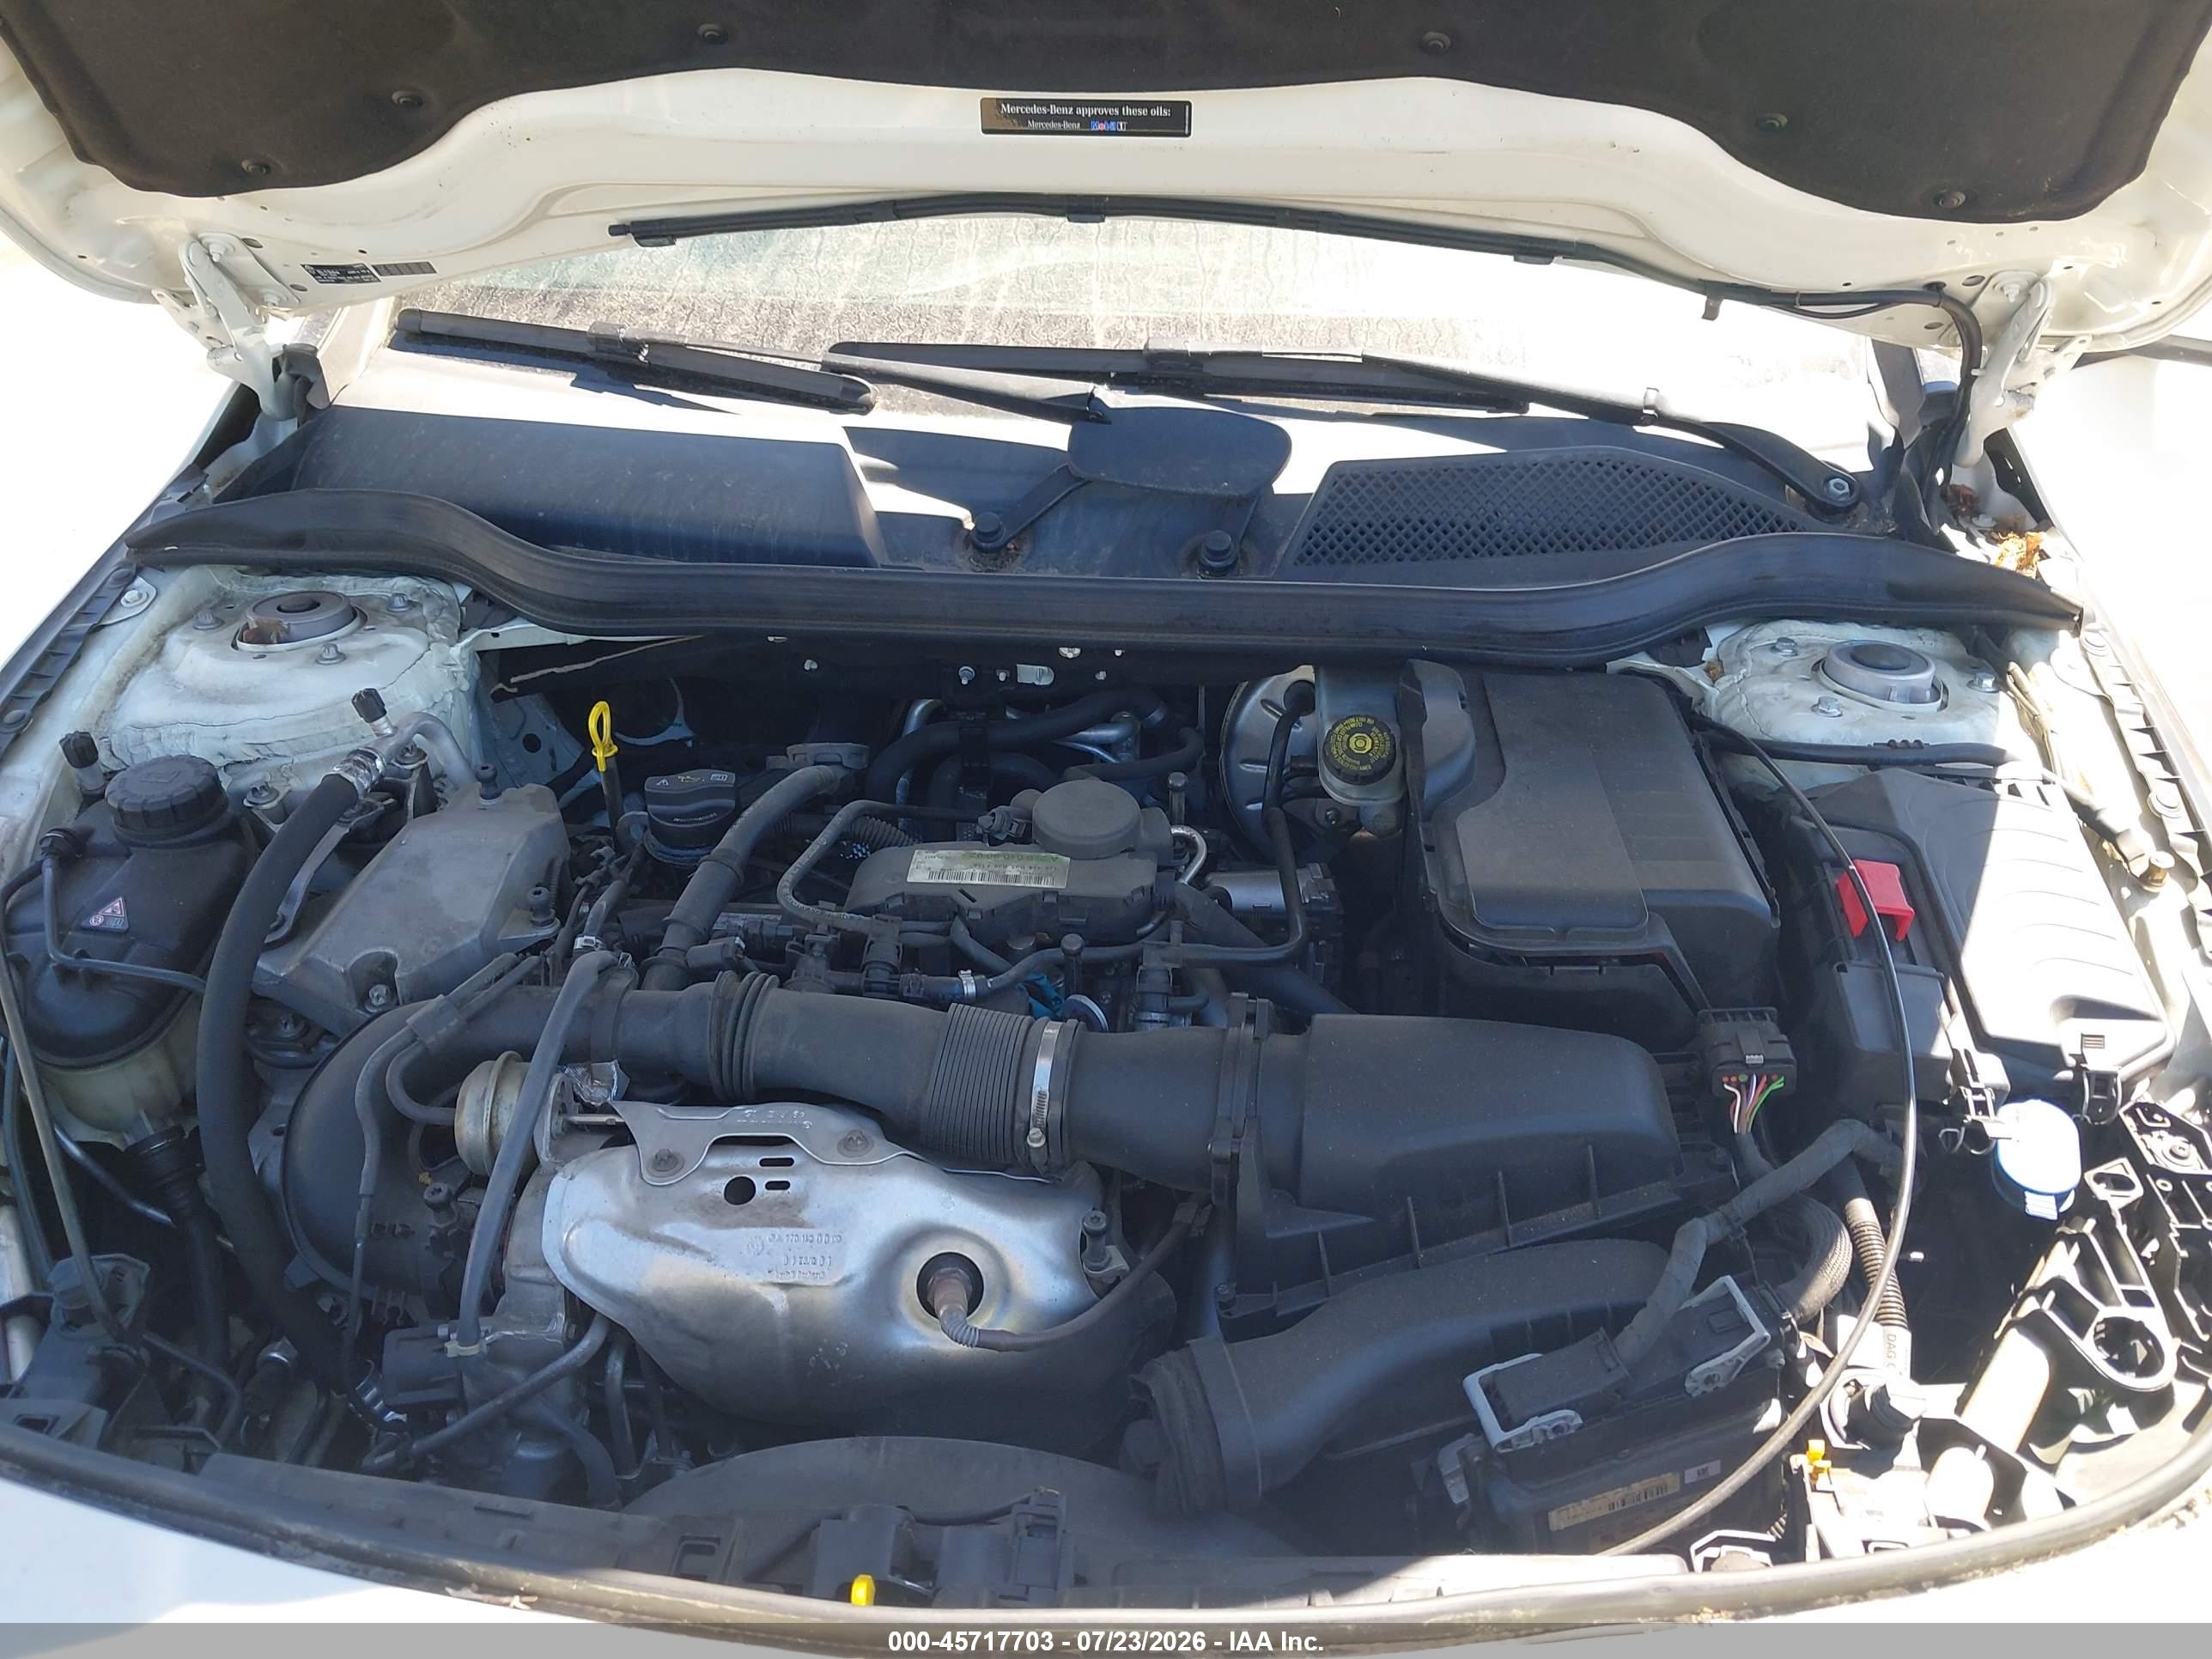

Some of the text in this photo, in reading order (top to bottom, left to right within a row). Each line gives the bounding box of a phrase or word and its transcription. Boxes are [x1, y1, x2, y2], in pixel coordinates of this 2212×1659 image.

[1000, 103, 1171, 118] Mercedes-Benz approves these oils:
[1028, 120, 1080, 130] Mercedes-Benz
[1091, 121, 1116, 131] Mobil
